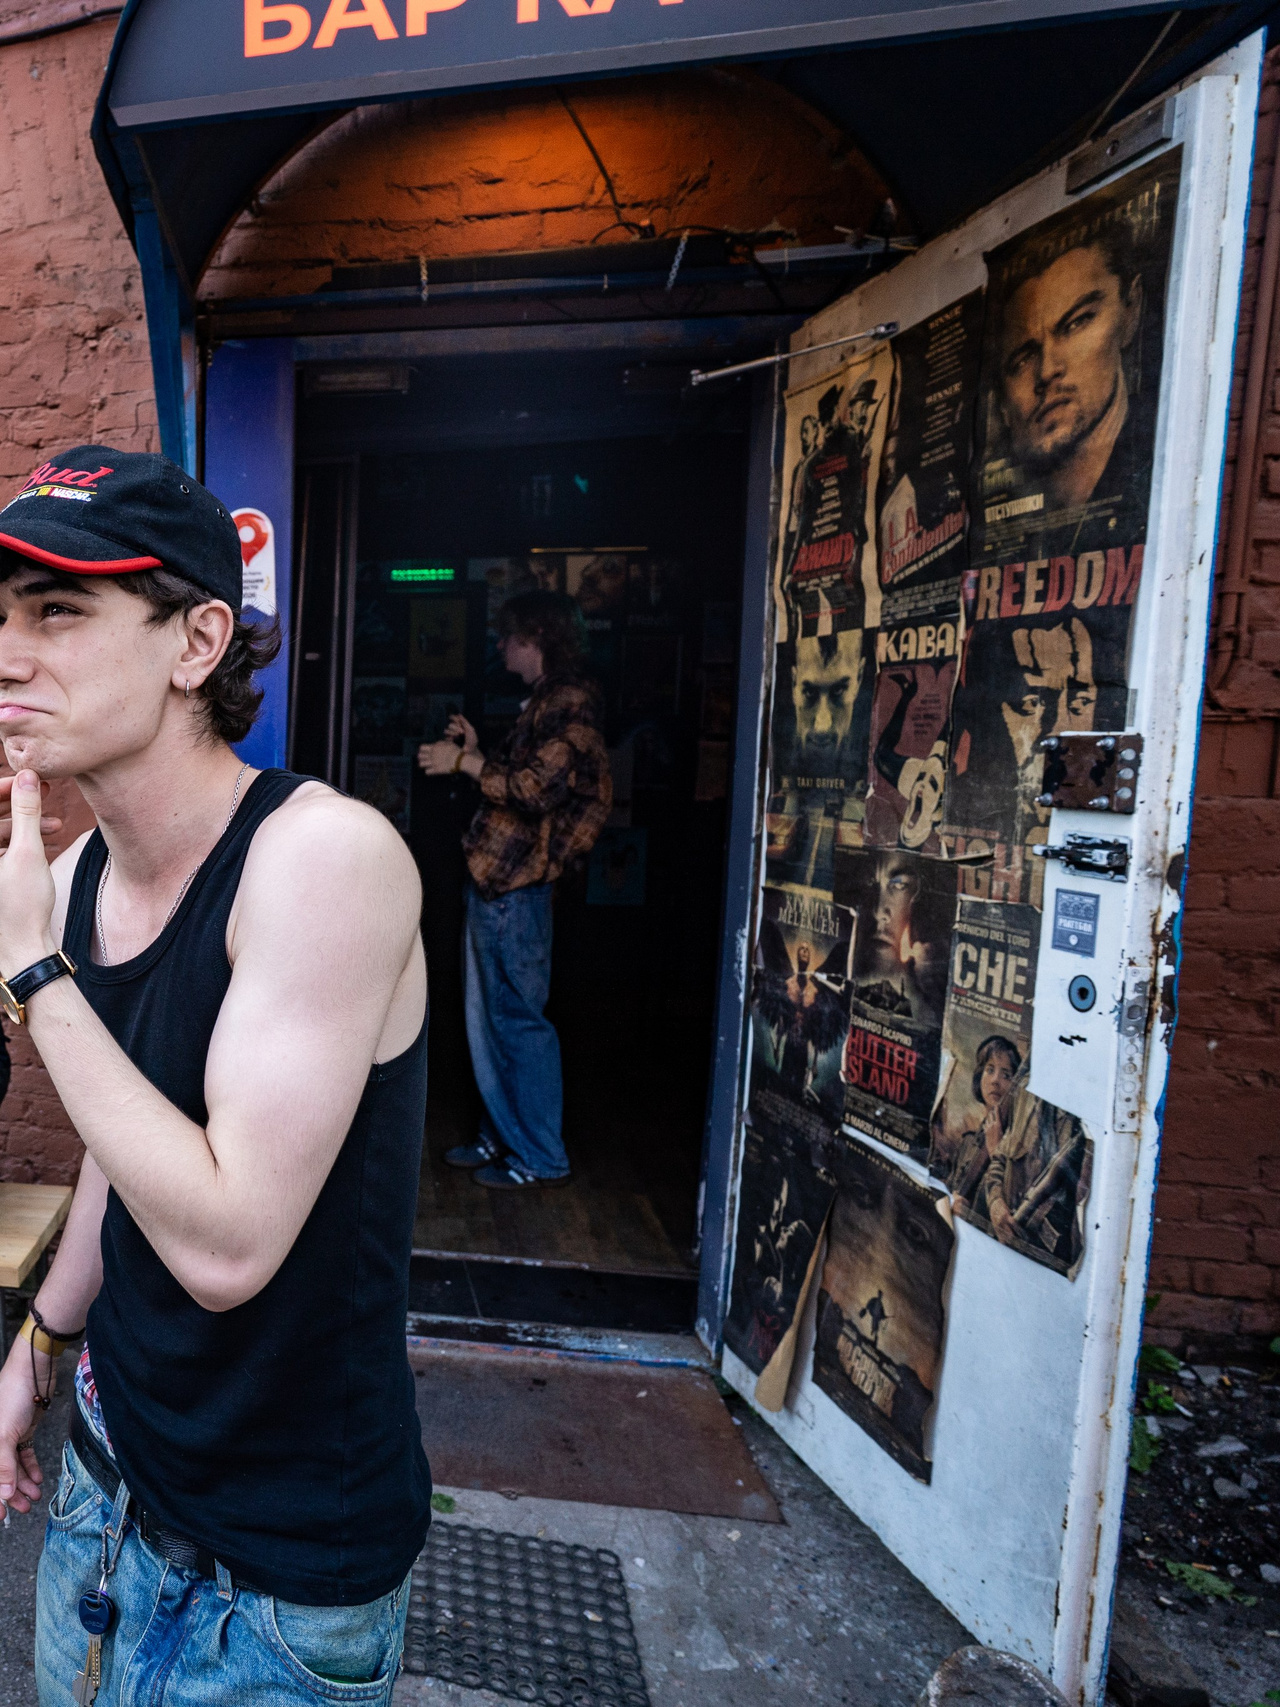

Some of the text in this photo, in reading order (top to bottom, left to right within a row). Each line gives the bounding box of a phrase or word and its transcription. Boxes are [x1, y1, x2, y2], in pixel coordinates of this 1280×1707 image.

[989, 931, 1006, 944] DEL
[953, 942, 1029, 1005] CHE
[851, 1013, 882, 1035] EONARDO
[847, 1025, 918, 1081] HUTTER
[849, 1055, 910, 1106] SLAND
